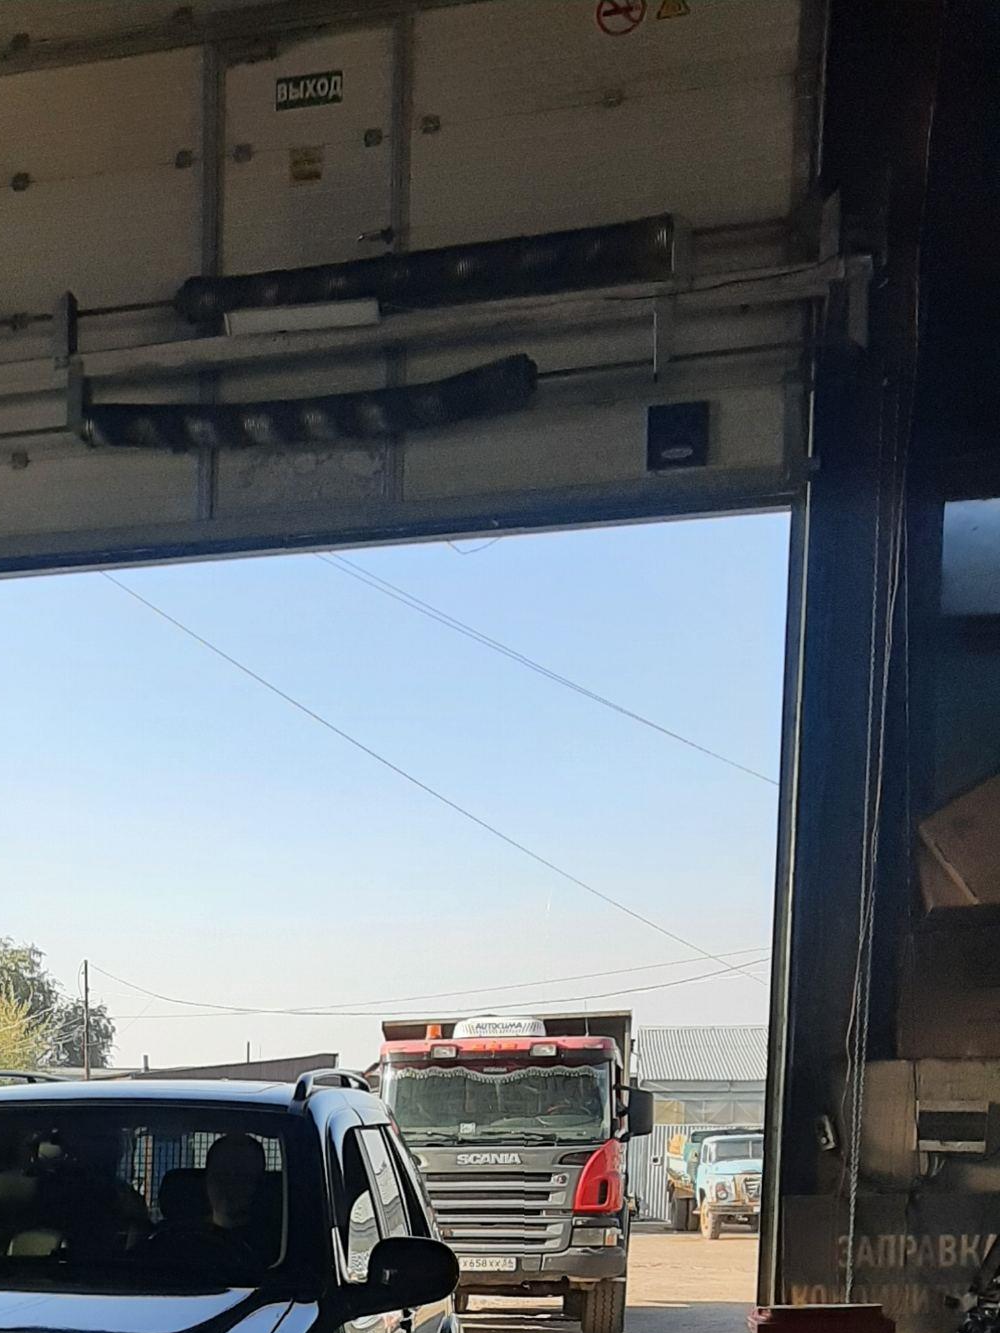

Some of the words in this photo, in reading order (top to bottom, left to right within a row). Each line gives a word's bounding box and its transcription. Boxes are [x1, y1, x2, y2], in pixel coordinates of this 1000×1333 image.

[277, 75, 342, 102] ВЫХОД
[475, 1022, 523, 1030] AUTOCLIMA
[456, 1153, 522, 1165] SCANIA
